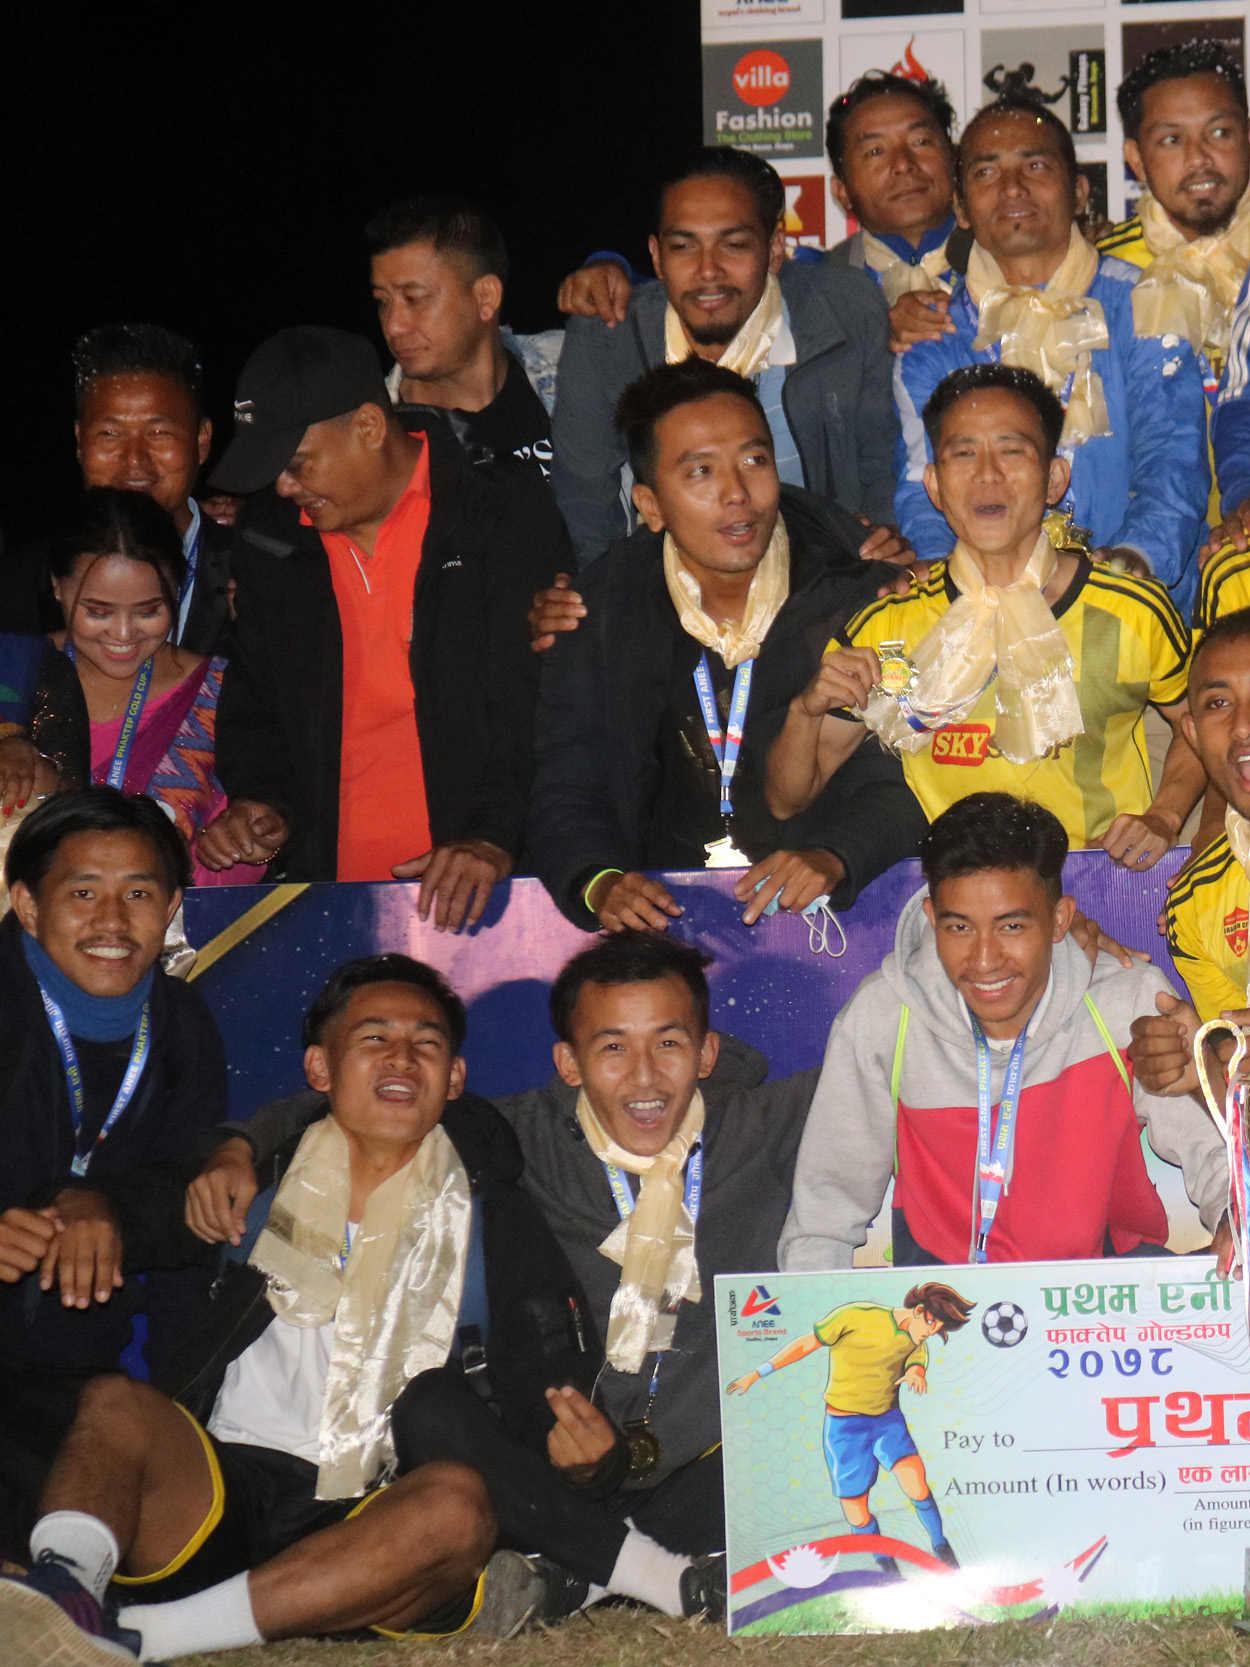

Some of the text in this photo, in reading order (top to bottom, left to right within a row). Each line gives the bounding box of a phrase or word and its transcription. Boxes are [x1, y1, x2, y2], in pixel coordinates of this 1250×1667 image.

[734, 65, 789, 88] villa
[716, 106, 813, 132] Fashion
[128, 692, 142, 716] GOLD
[697, 666, 716, 724] FIRST ANEE
[116, 716, 135, 758] PHAKTEP
[933, 731, 989, 758] SKY
[110, 759, 124, 786] ANEE
[107, 1096, 126, 1125] FIRST
[122, 1065, 140, 1095] ANEE
[133, 1013, 149, 1065] PHAKTEP
[977, 1040, 987, 1092] PHAKTEP
[979, 1093, 988, 1123] ANEE
[980, 1125, 988, 1158] FIRST
[1040, 1267, 1235, 1321] प्रथम एनी
[736, 1328, 787, 1337] Sports Brand
[1045, 1320, 1232, 1345] फाक्तेप गोल्डकप
[1047, 1347, 1174, 1379] २०७८
[943, 1430, 1015, 1453] Pay to
[944, 1470, 1167, 1498] Amount (In words)
[1177, 1466, 1213, 1485] एक
[1182, 1518, 1204, 1534] (in
